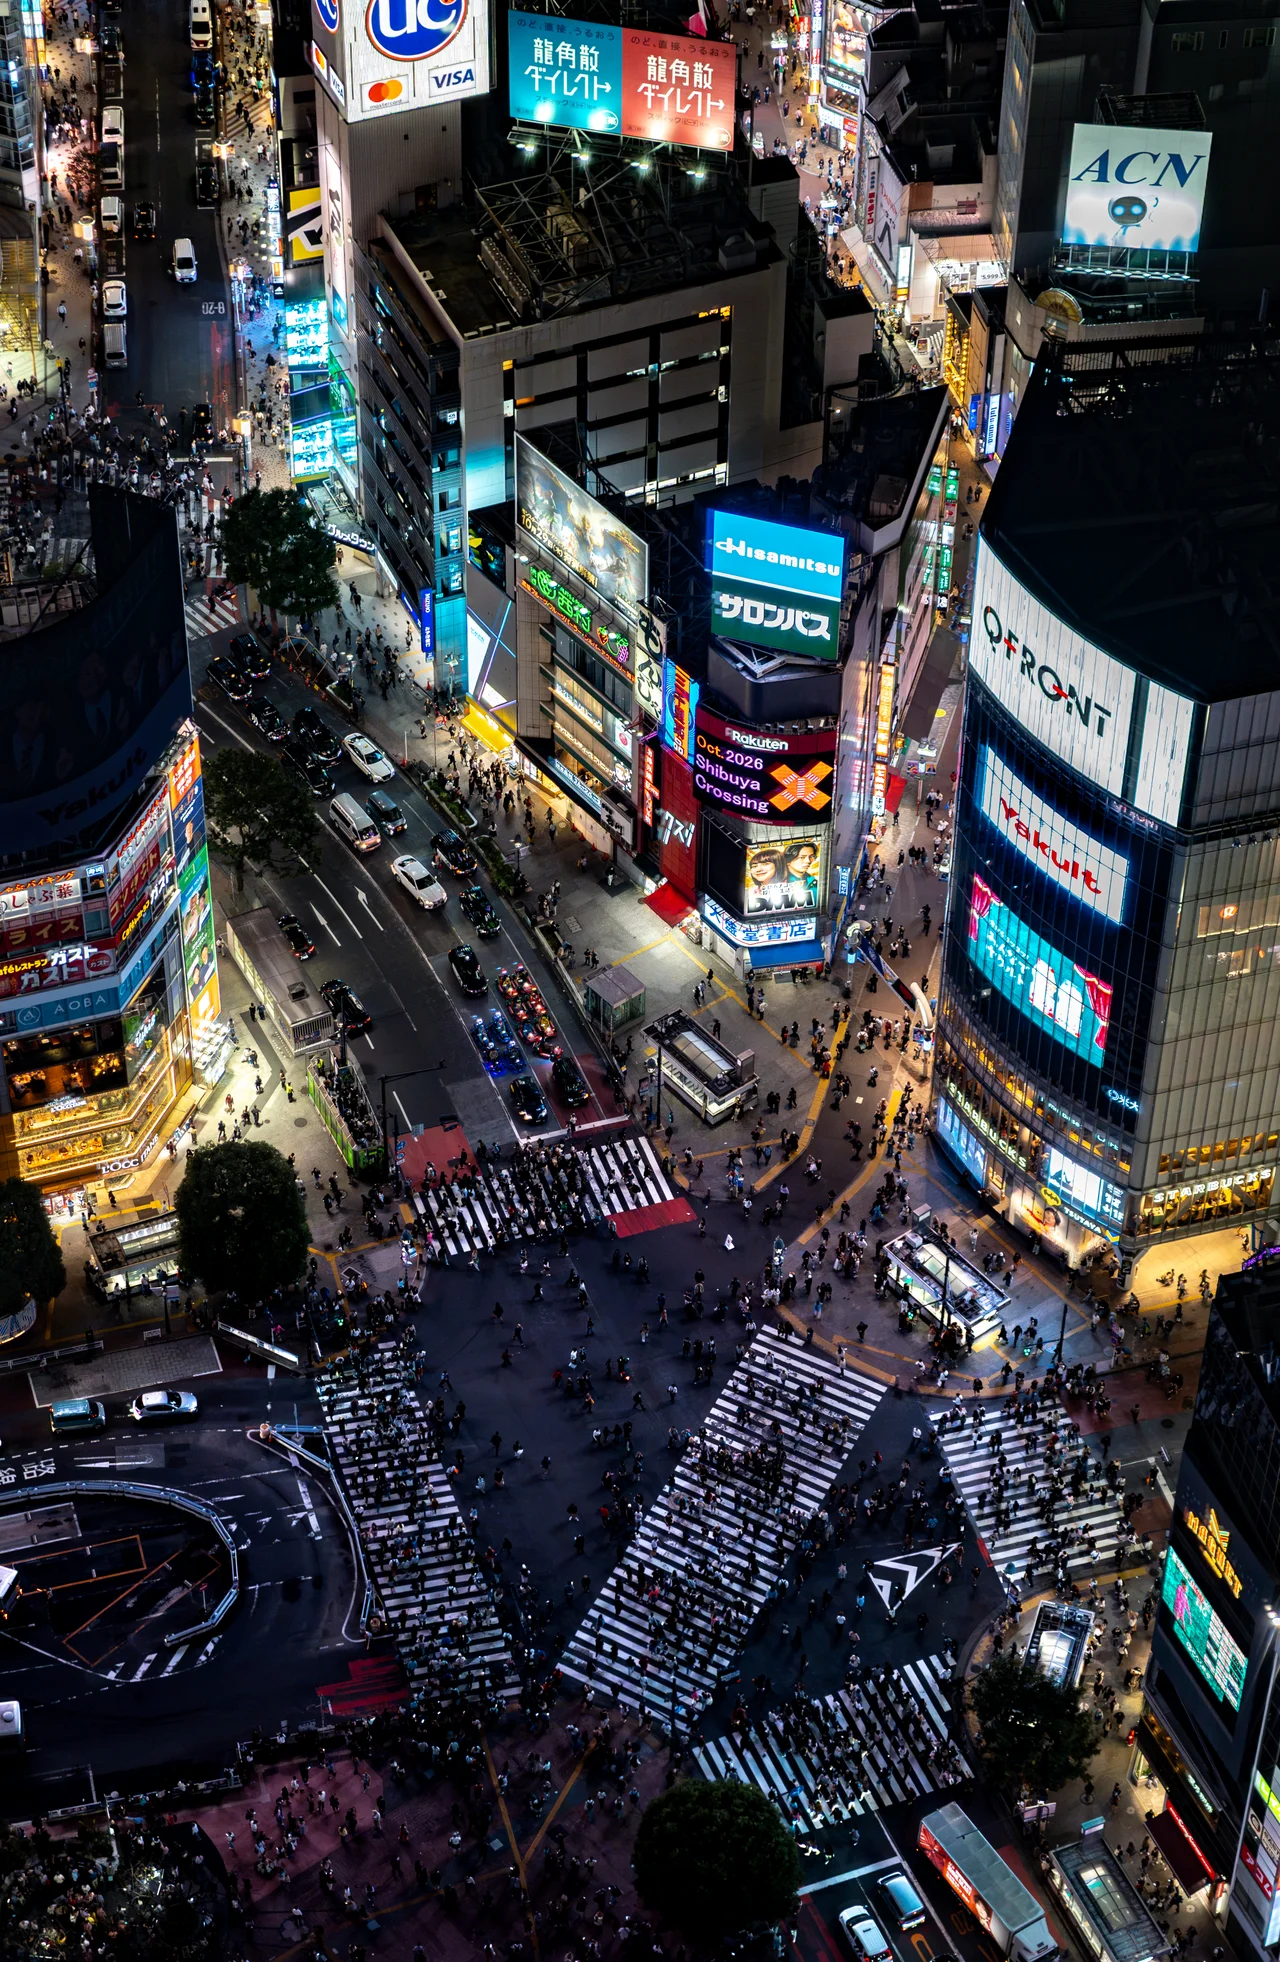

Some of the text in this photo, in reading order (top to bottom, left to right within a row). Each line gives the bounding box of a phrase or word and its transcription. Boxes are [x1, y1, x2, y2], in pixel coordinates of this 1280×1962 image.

[517, 18, 615, 41] のど、直接、うるおう
[631, 36, 730, 58] のど、直接、うるおう
[533, 37, 600, 72] 龍角散
[646, 54, 714, 90] 龍角散
[331, 73, 344, 98] VISA
[431, 69, 475, 89] VISA
[524, 65, 612, 101] ダイレクト
[369, 99, 403, 110] mastercard
[637, 82, 725, 118] ダイレクト
[1071, 148, 1207, 188] ACN
[327, 523, 375, 551] グルメタウン
[715, 537, 841, 577] Hisamitsu
[719, 593, 831, 641] サロンパス
[983, 605, 1112, 738] QFRONT
[696, 735, 764, 770] Oct. 2026
[732, 730, 789, 751] Rakuten
[695, 753, 761, 792] Shibuya
[695, 773, 770, 813] Crossing
[999, 797, 1103, 895] Yakult
[0, 869, 76, 897] ゃぶバイキング
[11, 883, 74, 909] しゃぶ葉
[150, 867, 173, 906] ガスト
[748, 891, 815, 914] DMM
[51, 944, 98, 967] ガスト
[20, 965, 79, 991] ガスト
[54, 994, 106, 1015] AOBA
[949, 1081, 1028, 1168] STARBUCKS
[1153, 1168, 1271, 1203] STARBUCKS
[1063, 1206, 1102, 1234] TSUTAYA
[1187, 1510, 1243, 1599] MAGNET
[1246, 1851, 1272, 1897] アコム
